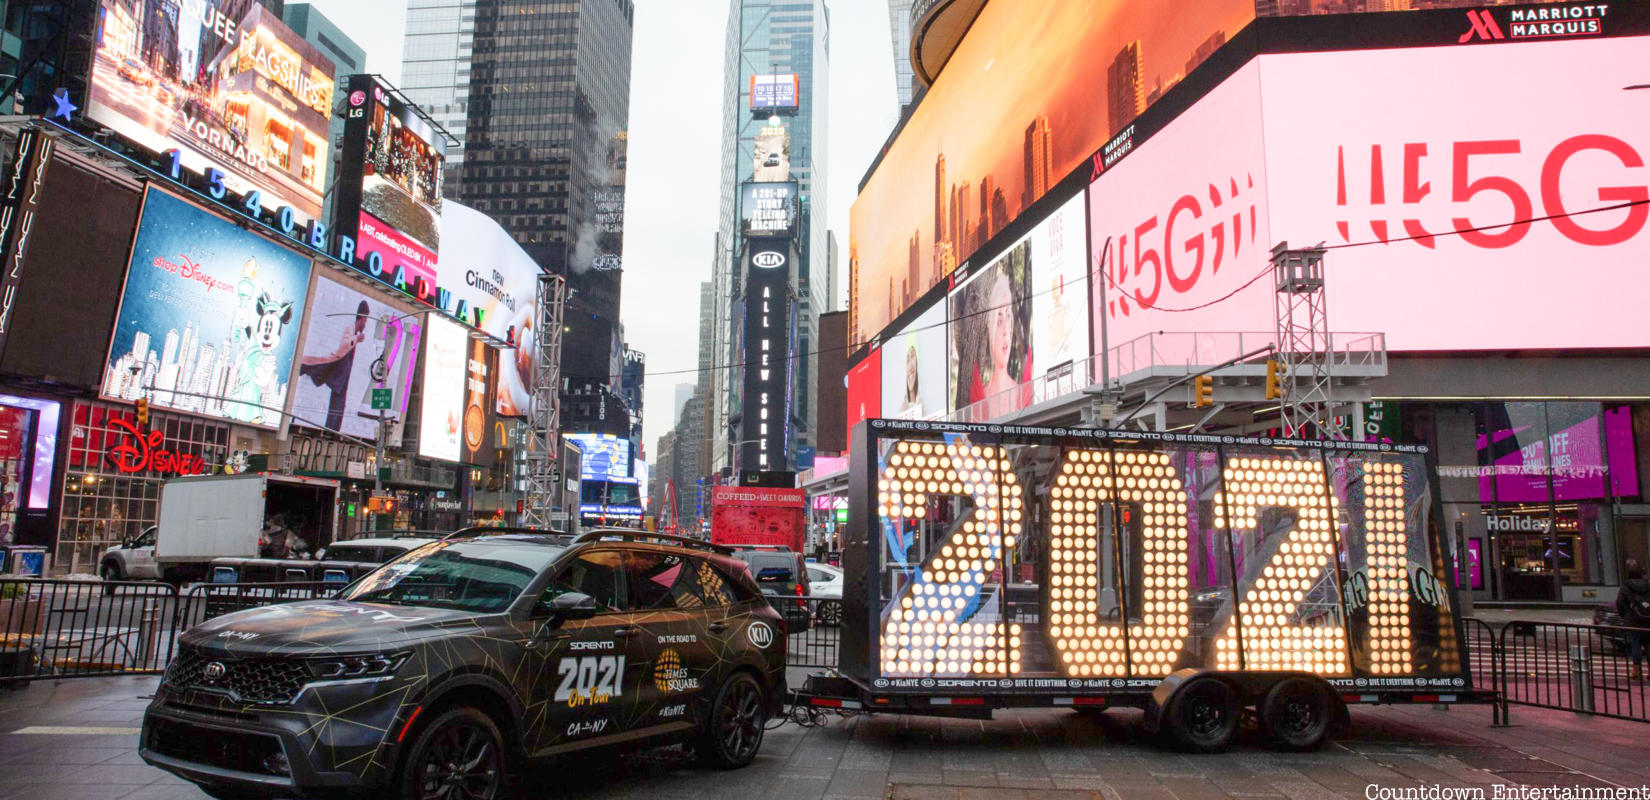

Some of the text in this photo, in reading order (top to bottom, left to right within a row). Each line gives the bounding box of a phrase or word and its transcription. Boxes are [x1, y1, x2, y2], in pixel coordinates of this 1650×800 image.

[1511, 5, 1608, 21] MARRIOTT
[1512, 20, 1598, 36] MARQUIS
[240, 29, 320, 104] FLAGSHIPS
[381, 92, 389, 107] LG
[350, 109, 363, 118] LG
[182, 113, 268, 173] VORNADO
[1105, 125, 1135, 155] MARRIOTT
[1105, 139, 1132, 167] MARQUIS
[751, 220, 788, 231] MACHINE
[168, 148, 487, 331] 1540 BROADWAY
[756, 253, 782, 266] KIA
[492, 269, 504, 287] new
[466, 269, 516, 312] Cinnamon Roll
[888, 421, 914, 429] #KiaNYE
[931, 423, 987, 431] SORENTO
[1004, 426, 1015, 434] GIVE
[1022, 427, 1052, 435] EVERYTHING
[1068, 429, 1093, 437] #KiaNYE
[1109, 431, 1160, 439] SORENTO
[1273, 439, 1322, 447] SORENTO
[716, 492, 756, 501] COFFEED
[1487, 515, 1551, 533] Holiday
[877, 440, 1413, 678] 2021
[658, 634, 697, 644] ON THE ROAD TO
[750, 625, 770, 643] KIA
[570, 640, 614, 650] SORENTO
[554, 655, 625, 702] 2021
[665, 667, 688, 680] TIMES
[668, 678, 699, 691] SQUARE
[891, 679, 919, 687] #KiaNYE
[1015, 679, 1027, 687] GIVE
[1034, 679, 1067, 687] EVERYTHING
[1084, 679, 1110, 687] #KiaNYE
[567, 687, 609, 708] On Tour
[659, 704, 687, 718] #KiaNYE
[567, 723, 580, 736] CA
[592, 719, 608, 732] NY
